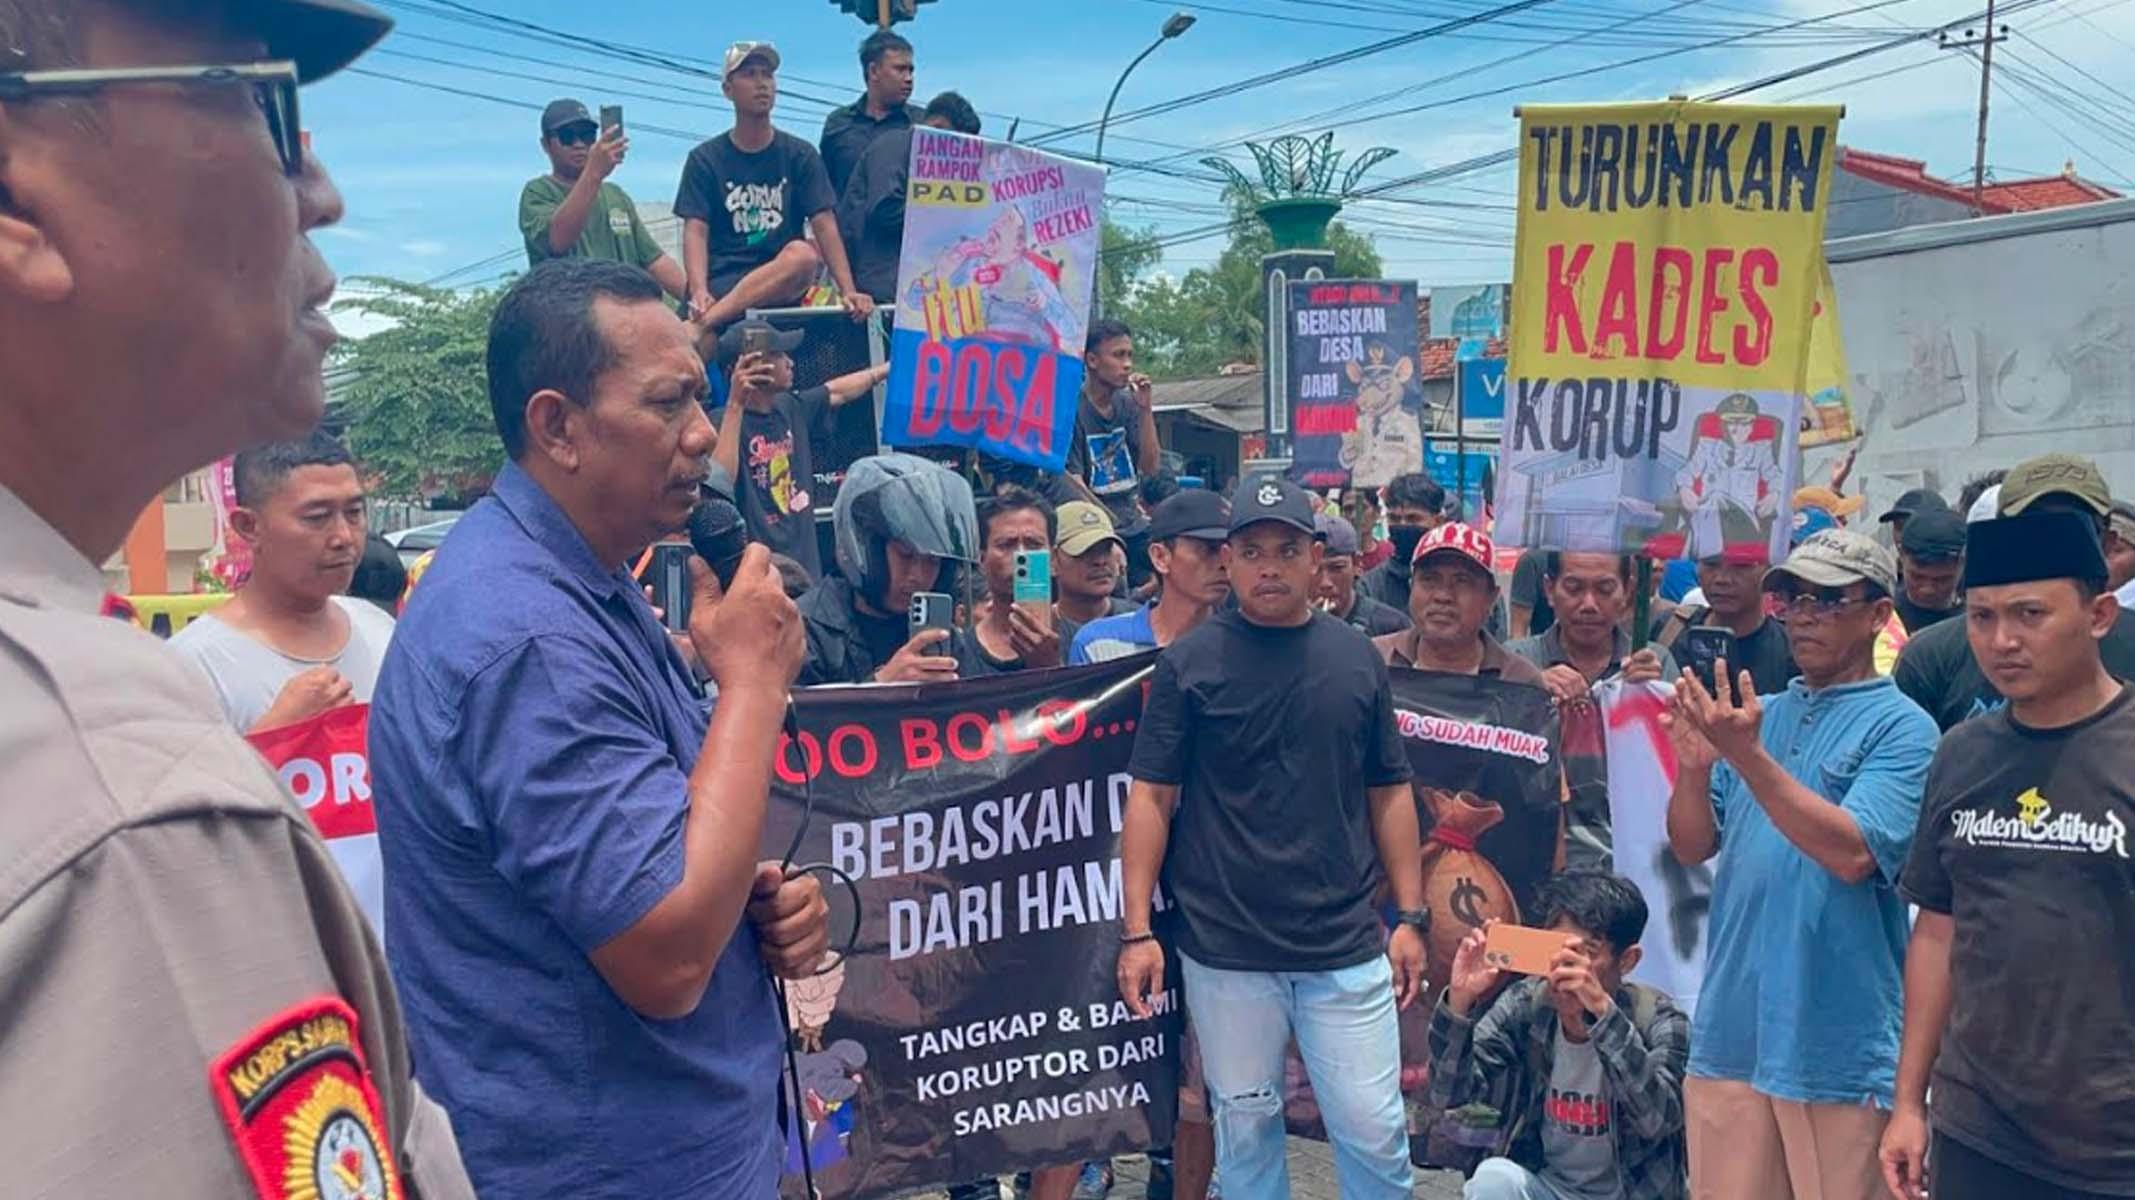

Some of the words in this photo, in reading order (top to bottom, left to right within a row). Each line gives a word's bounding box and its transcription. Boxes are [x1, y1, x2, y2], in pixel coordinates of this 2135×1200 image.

[918, 133, 984, 160] JANGAN
[916, 158, 982, 183] RAMPOK
[992, 165, 1066, 203] KORUPSI
[1530, 121, 1827, 213] TURUNKAN
[1033, 205, 1096, 244] REZEKI
[1297, 307, 1387, 336] BEBASKAN
[1544, 242, 1779, 366] KADES
[1319, 335, 1365, 362] DESA
[1301, 372, 1339, 398] DARI
[1513, 377, 1681, 461] KORUP
[1423, 522, 1487, 552] NYC
[1422, 716, 1490, 750] SUDAH
[832, 779, 1093, 883] BEBASKAN
[890, 881, 1002, 960] DARI
[900, 1012, 1047, 1061] TANGKAP
[1057, 1007, 1081, 1032] &
[1089, 988, 1177, 1029] BAMI
[917, 1049, 1090, 1101] KORUPTOR
[1098, 1032, 1165, 1071] DARI
[954, 1081, 1150, 1136] SARANGNYA
